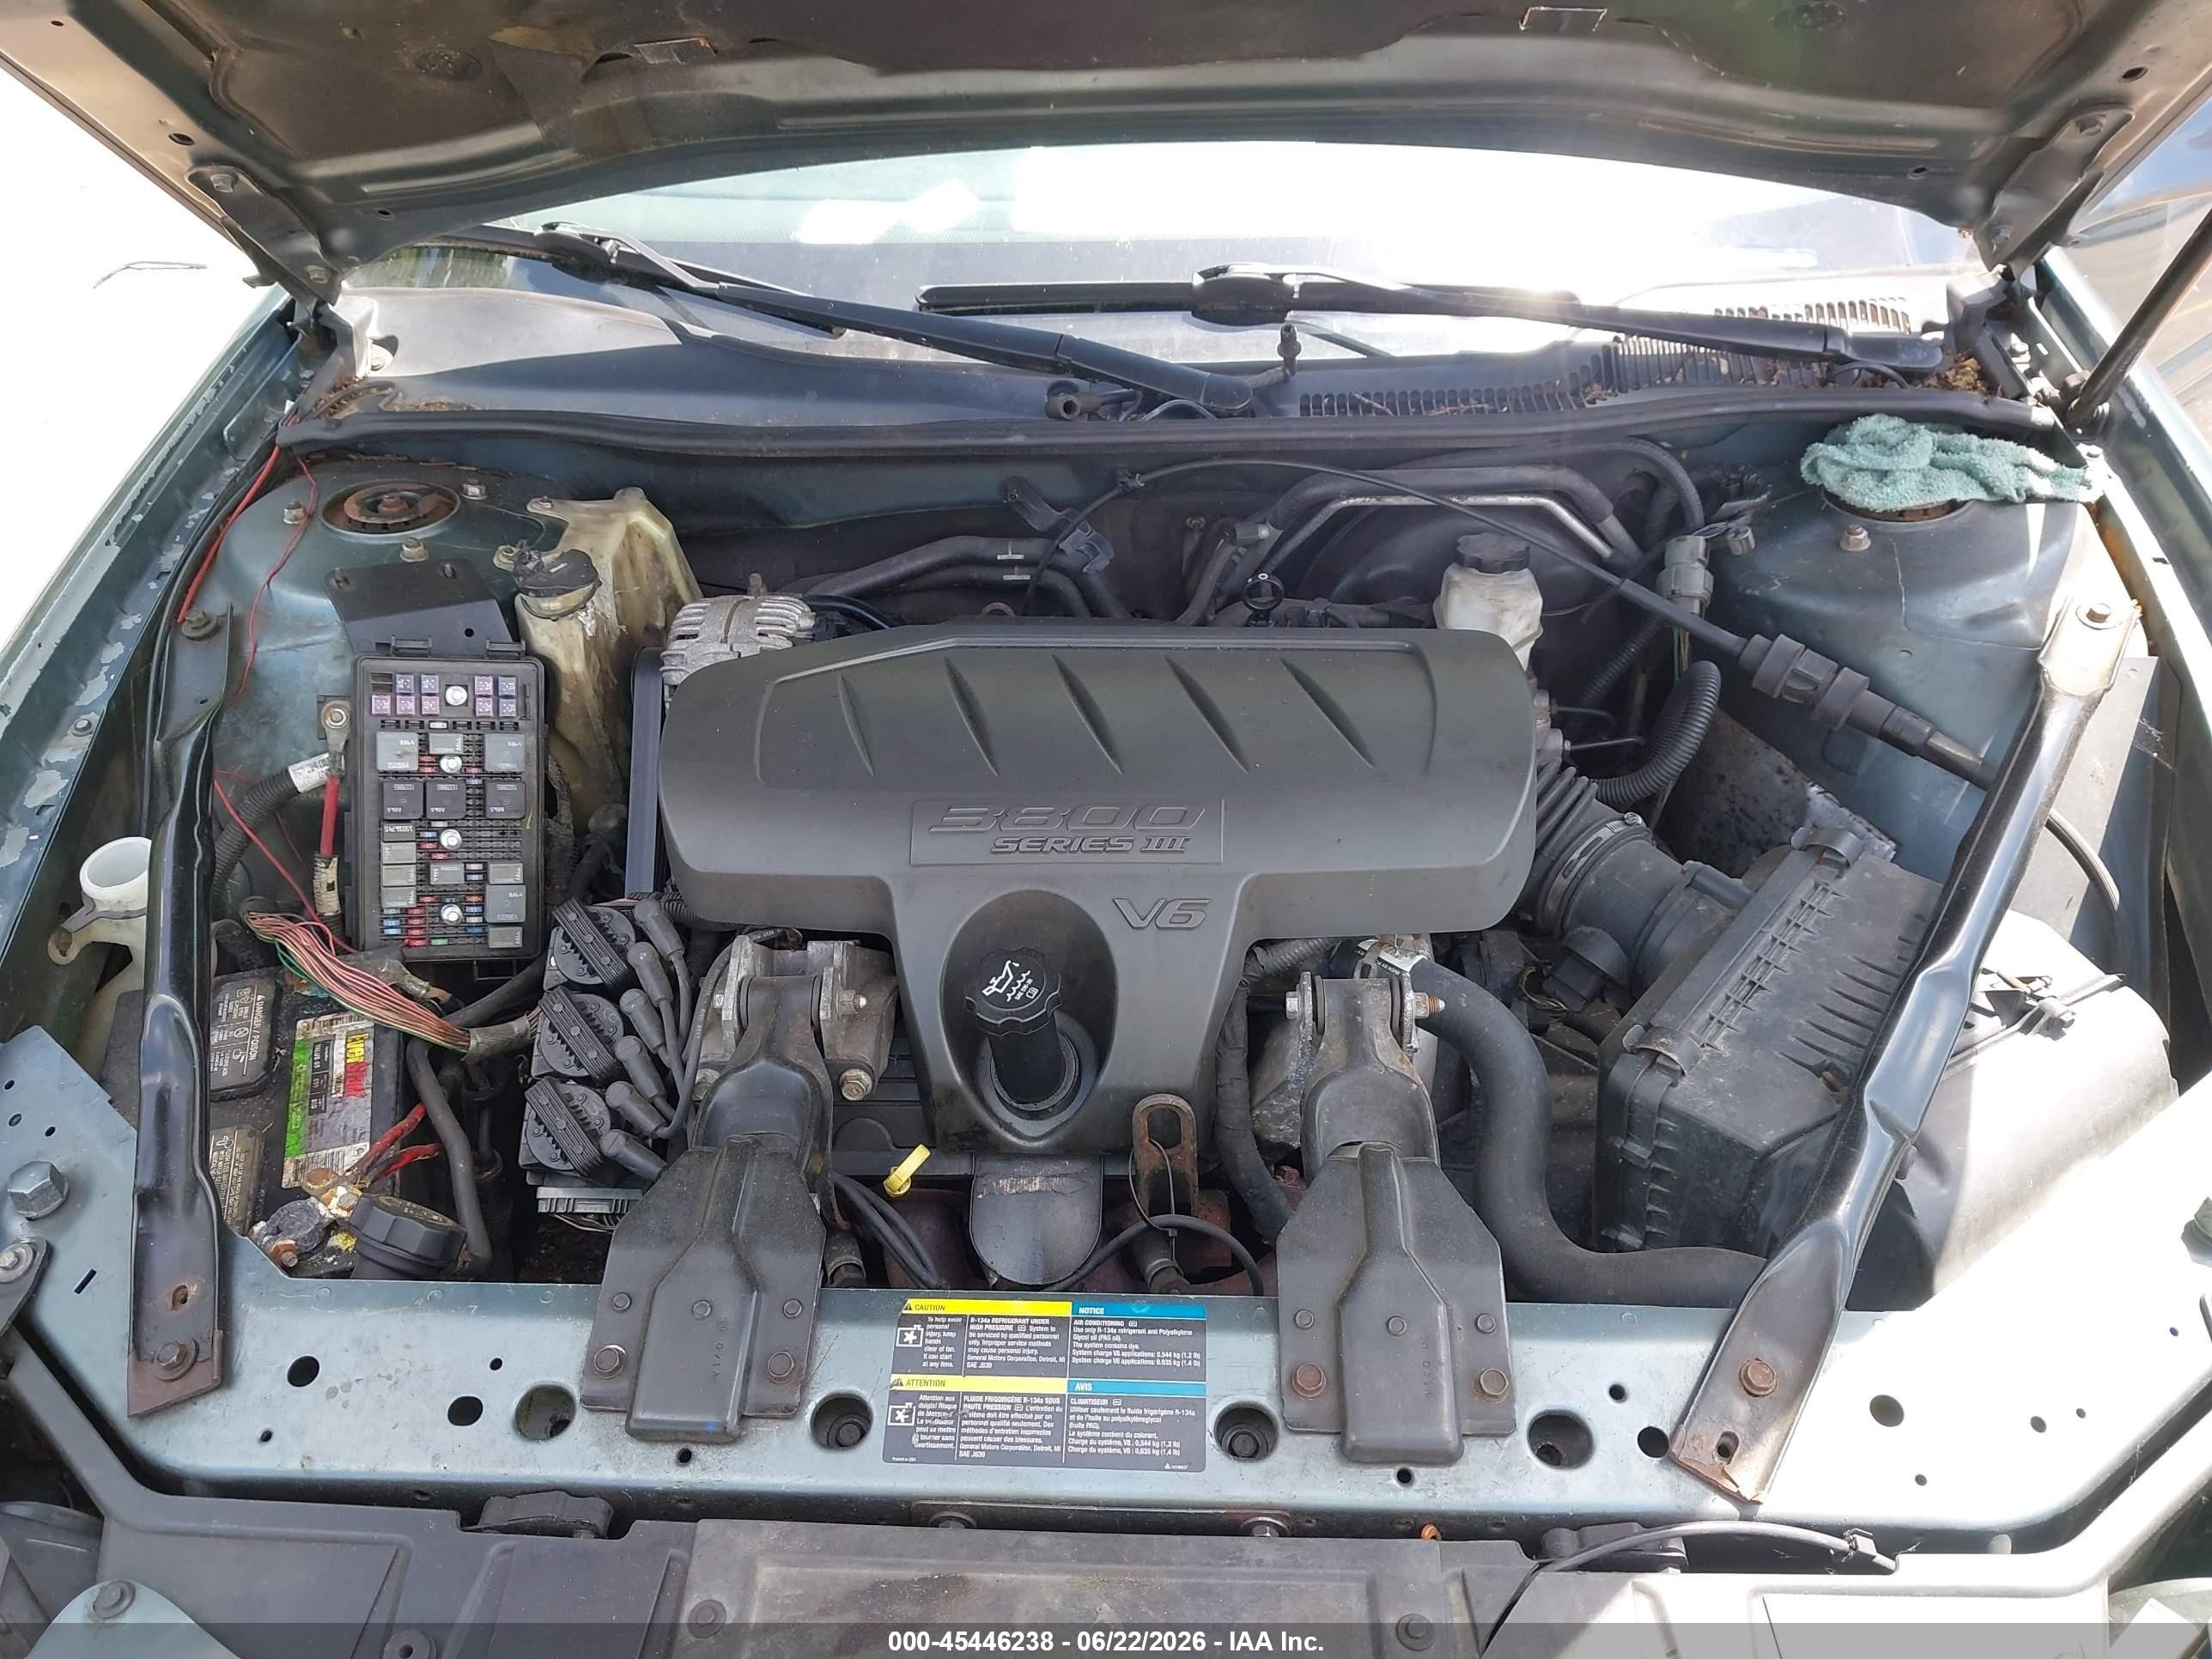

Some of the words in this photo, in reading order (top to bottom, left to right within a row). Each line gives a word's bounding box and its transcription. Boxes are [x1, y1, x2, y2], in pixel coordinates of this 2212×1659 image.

[929, 805, 1206, 832] 3800
[990, 836, 1134, 854] SERIES
[1139, 836, 1191, 854] III
[1112, 897, 1211, 930] V6
[252, 1000, 264, 1029] DANGER
[248, 1035, 260, 1060] POISON
[313, 1043, 322, 1060] VALUE
[313, 1060, 321, 1069] 65
[1075, 1382, 1093, 1391] AVIS
